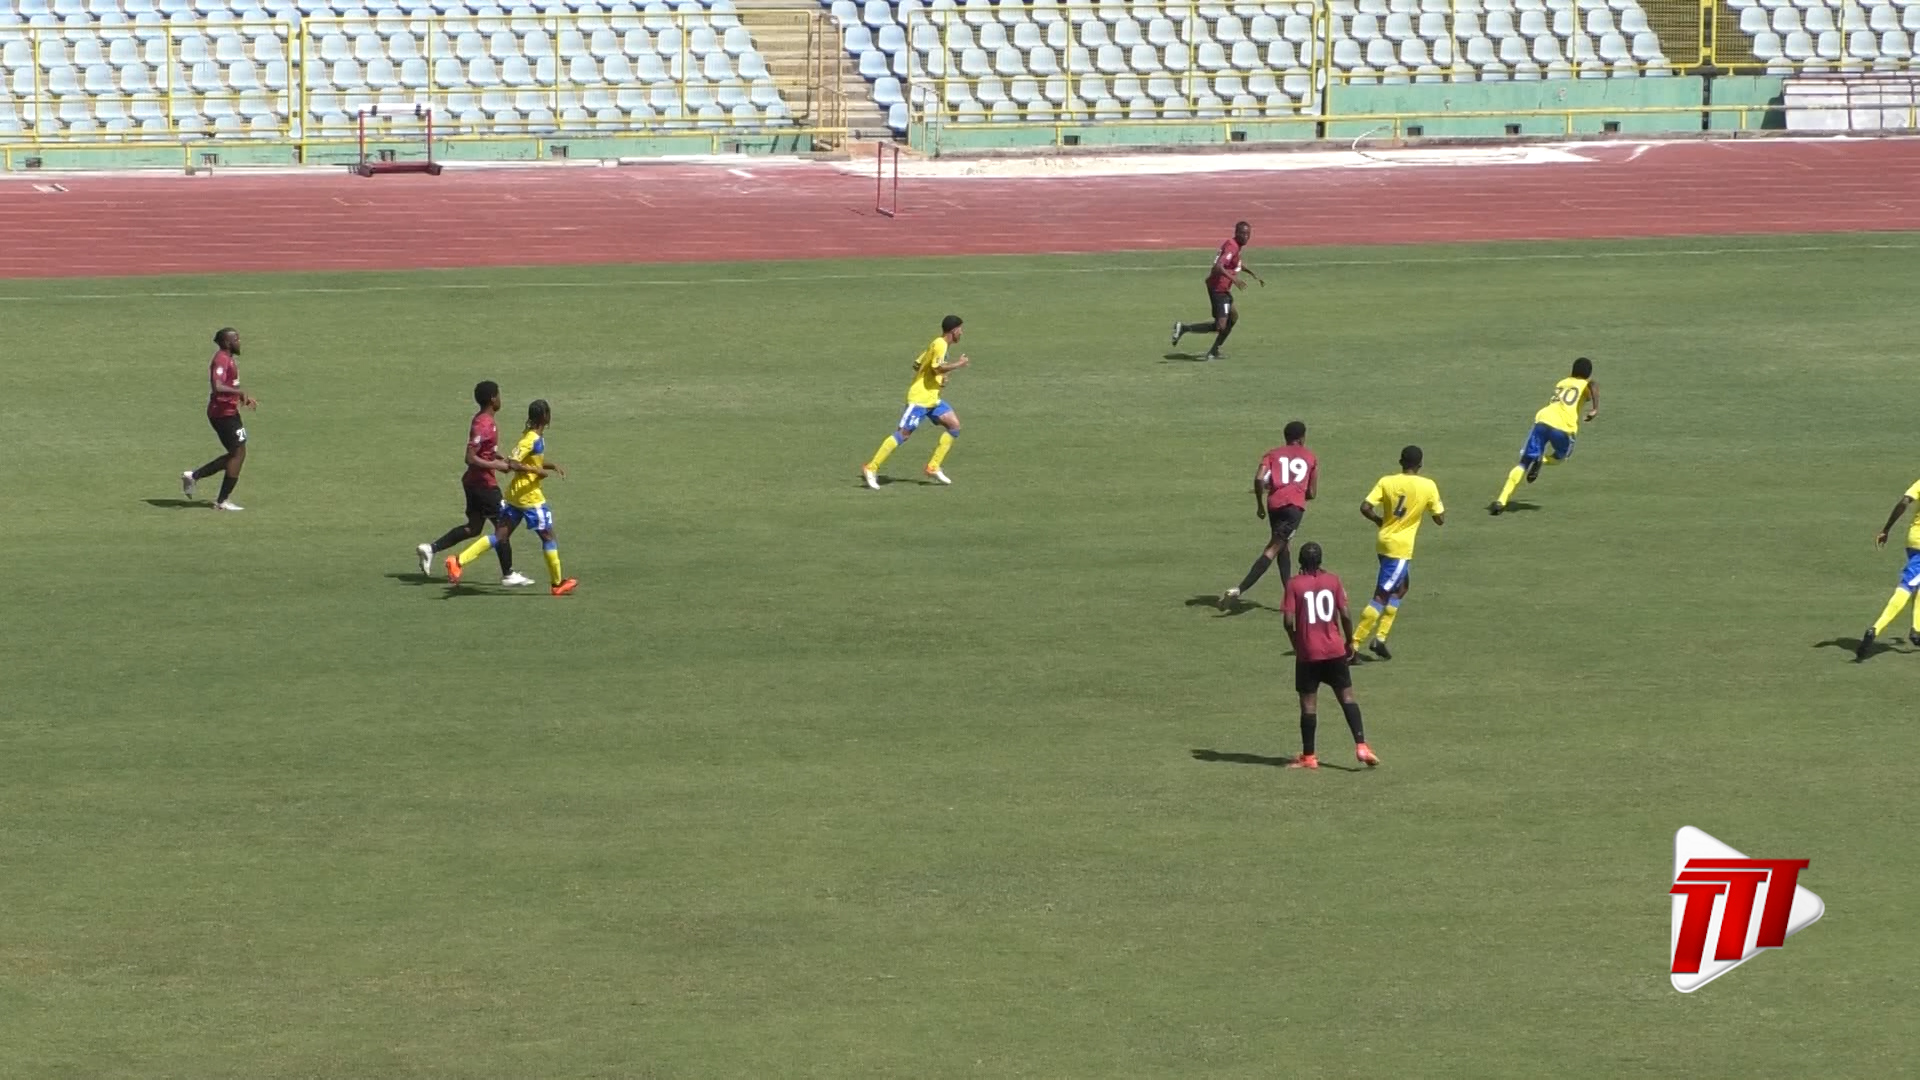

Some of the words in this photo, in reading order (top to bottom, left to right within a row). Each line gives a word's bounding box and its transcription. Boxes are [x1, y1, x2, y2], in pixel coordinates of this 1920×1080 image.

[1550, 386, 1579, 406] 20
[1278, 456, 1308, 484] 19
[1303, 588, 1335, 624] 10
